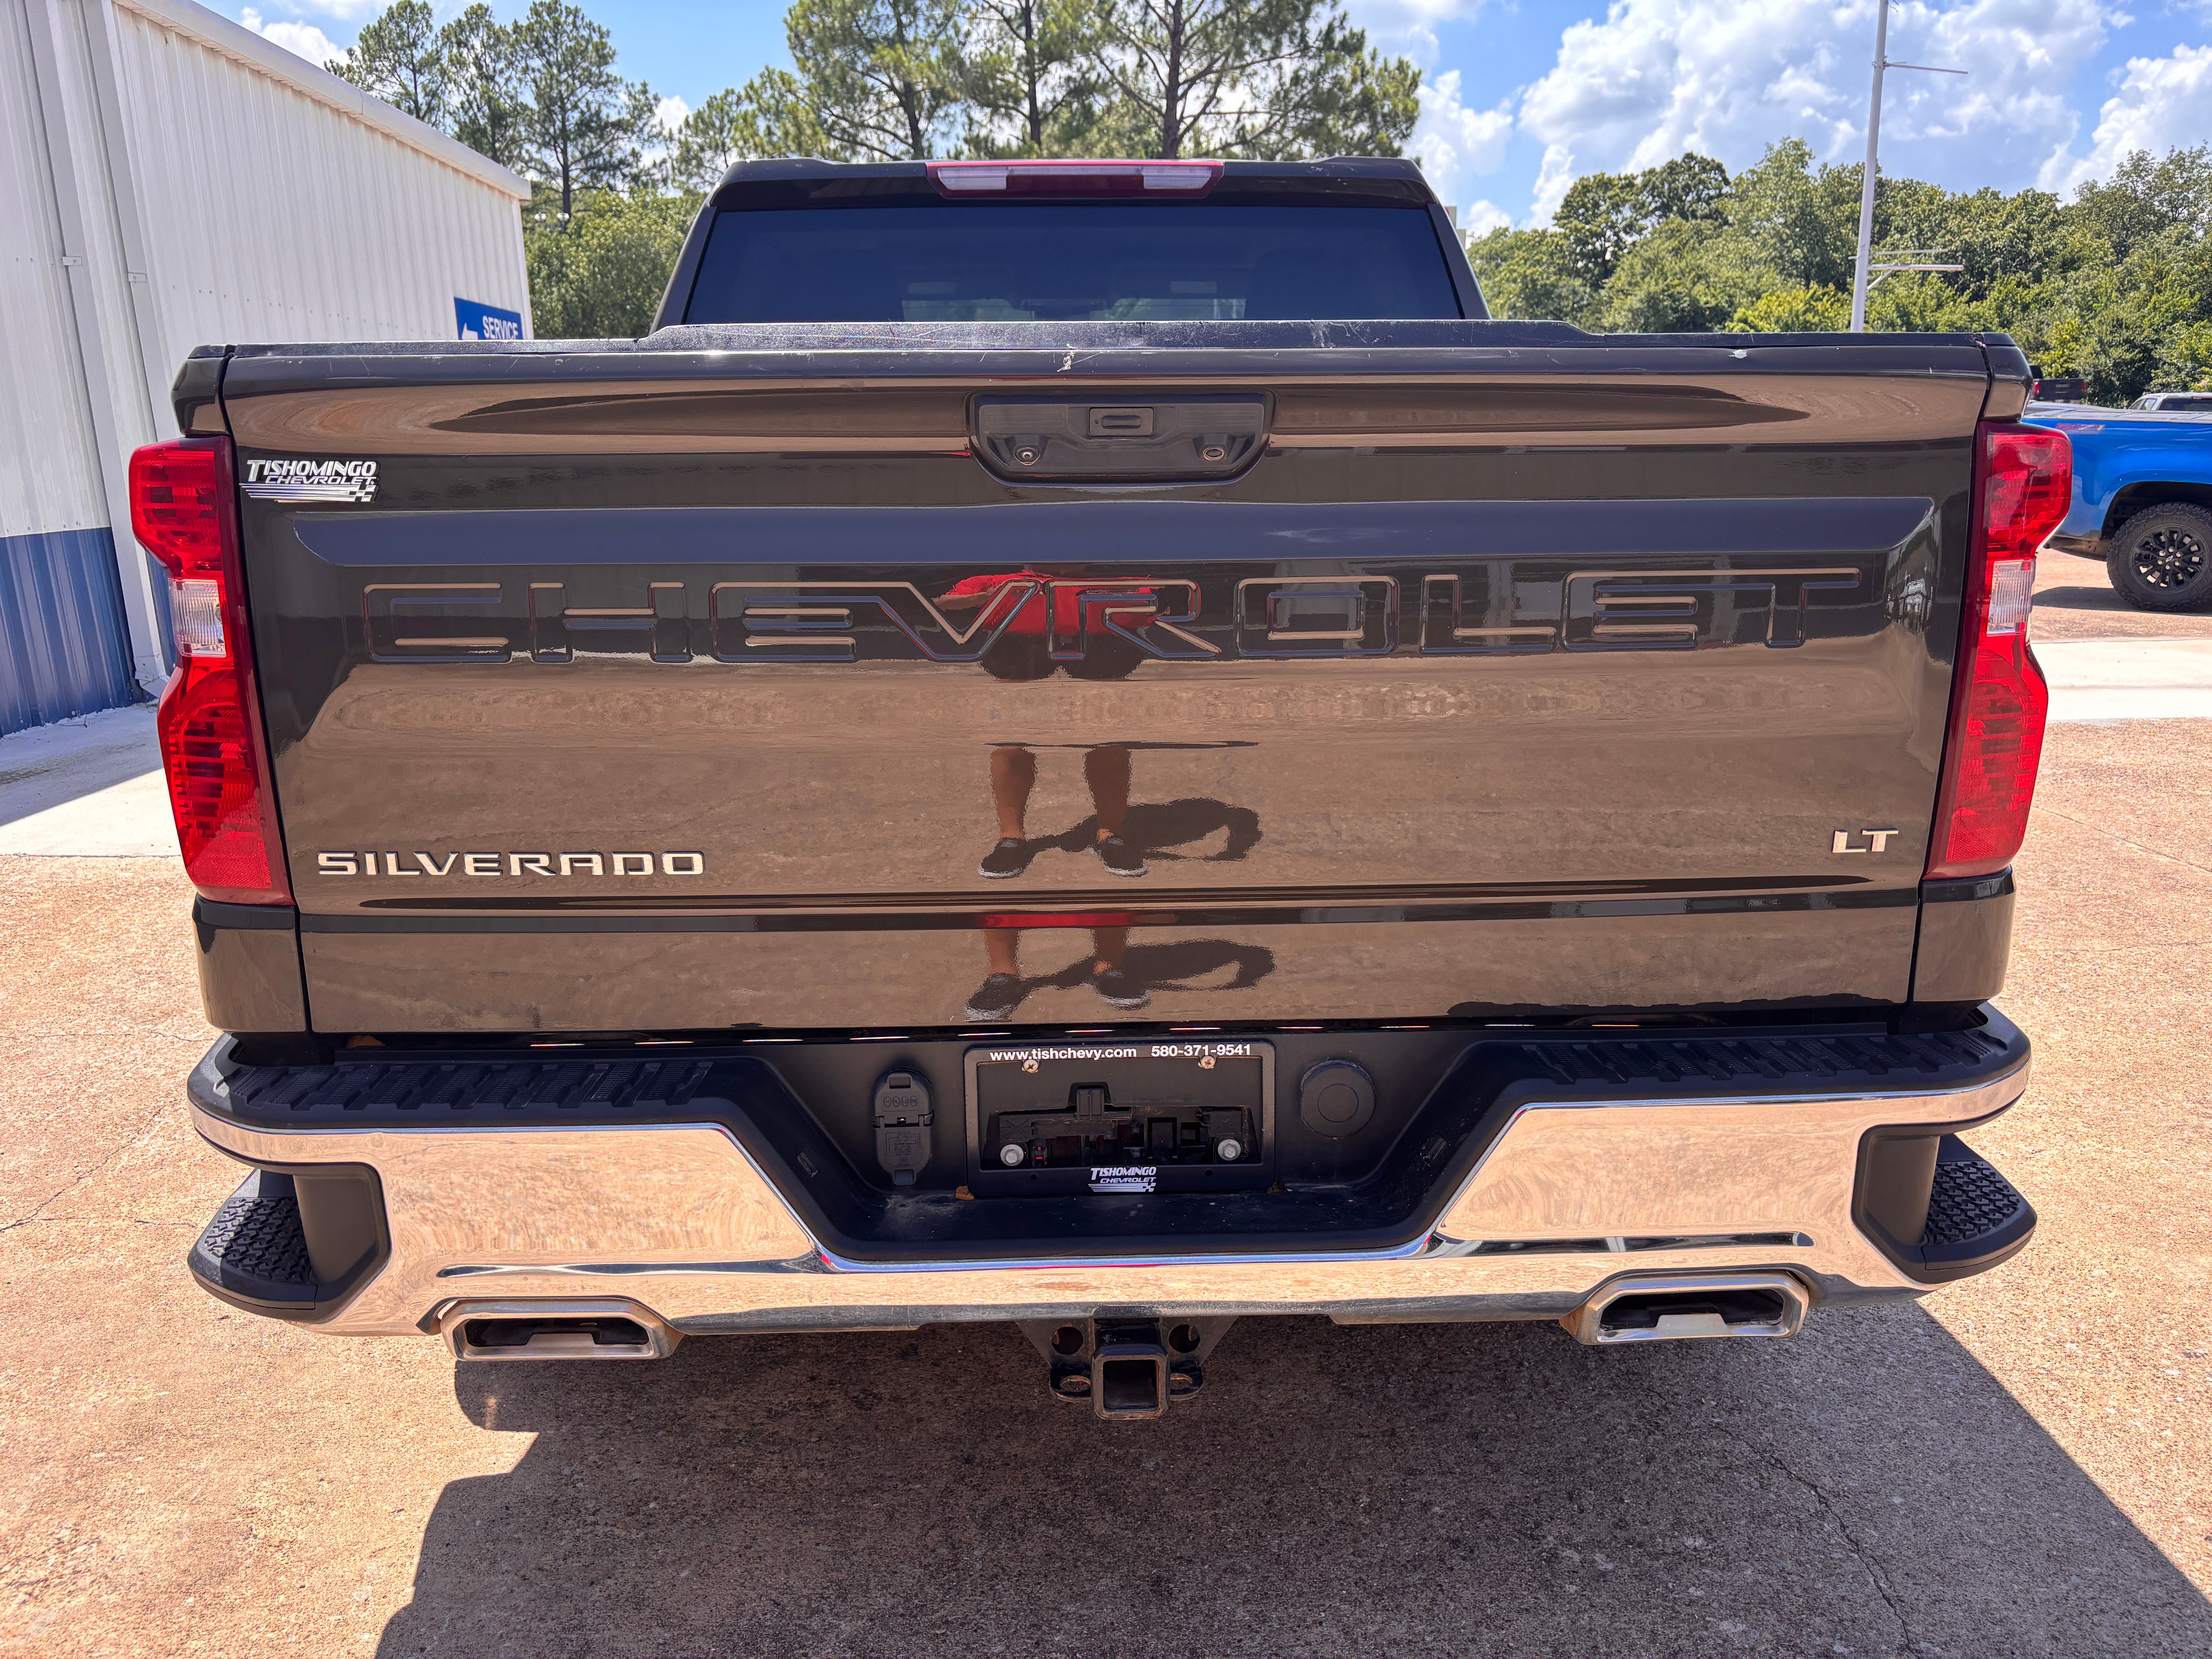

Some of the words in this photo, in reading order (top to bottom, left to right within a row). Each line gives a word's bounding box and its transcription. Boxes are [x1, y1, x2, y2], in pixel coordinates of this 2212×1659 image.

[483, 315, 518, 339] SERVICE
[247, 460, 376, 481] TISHOMINGO
[363, 567, 1861, 664] CHEVROLET
[1832, 828, 1898, 853] LT
[317, 851, 704, 876] SILVERADO
[989, 1048, 1137, 1061] www.tishchevy.com
[1151, 1044, 1250, 1057] 580-371-9541
[1091, 1166, 1157, 1180] TISHOMINGO
